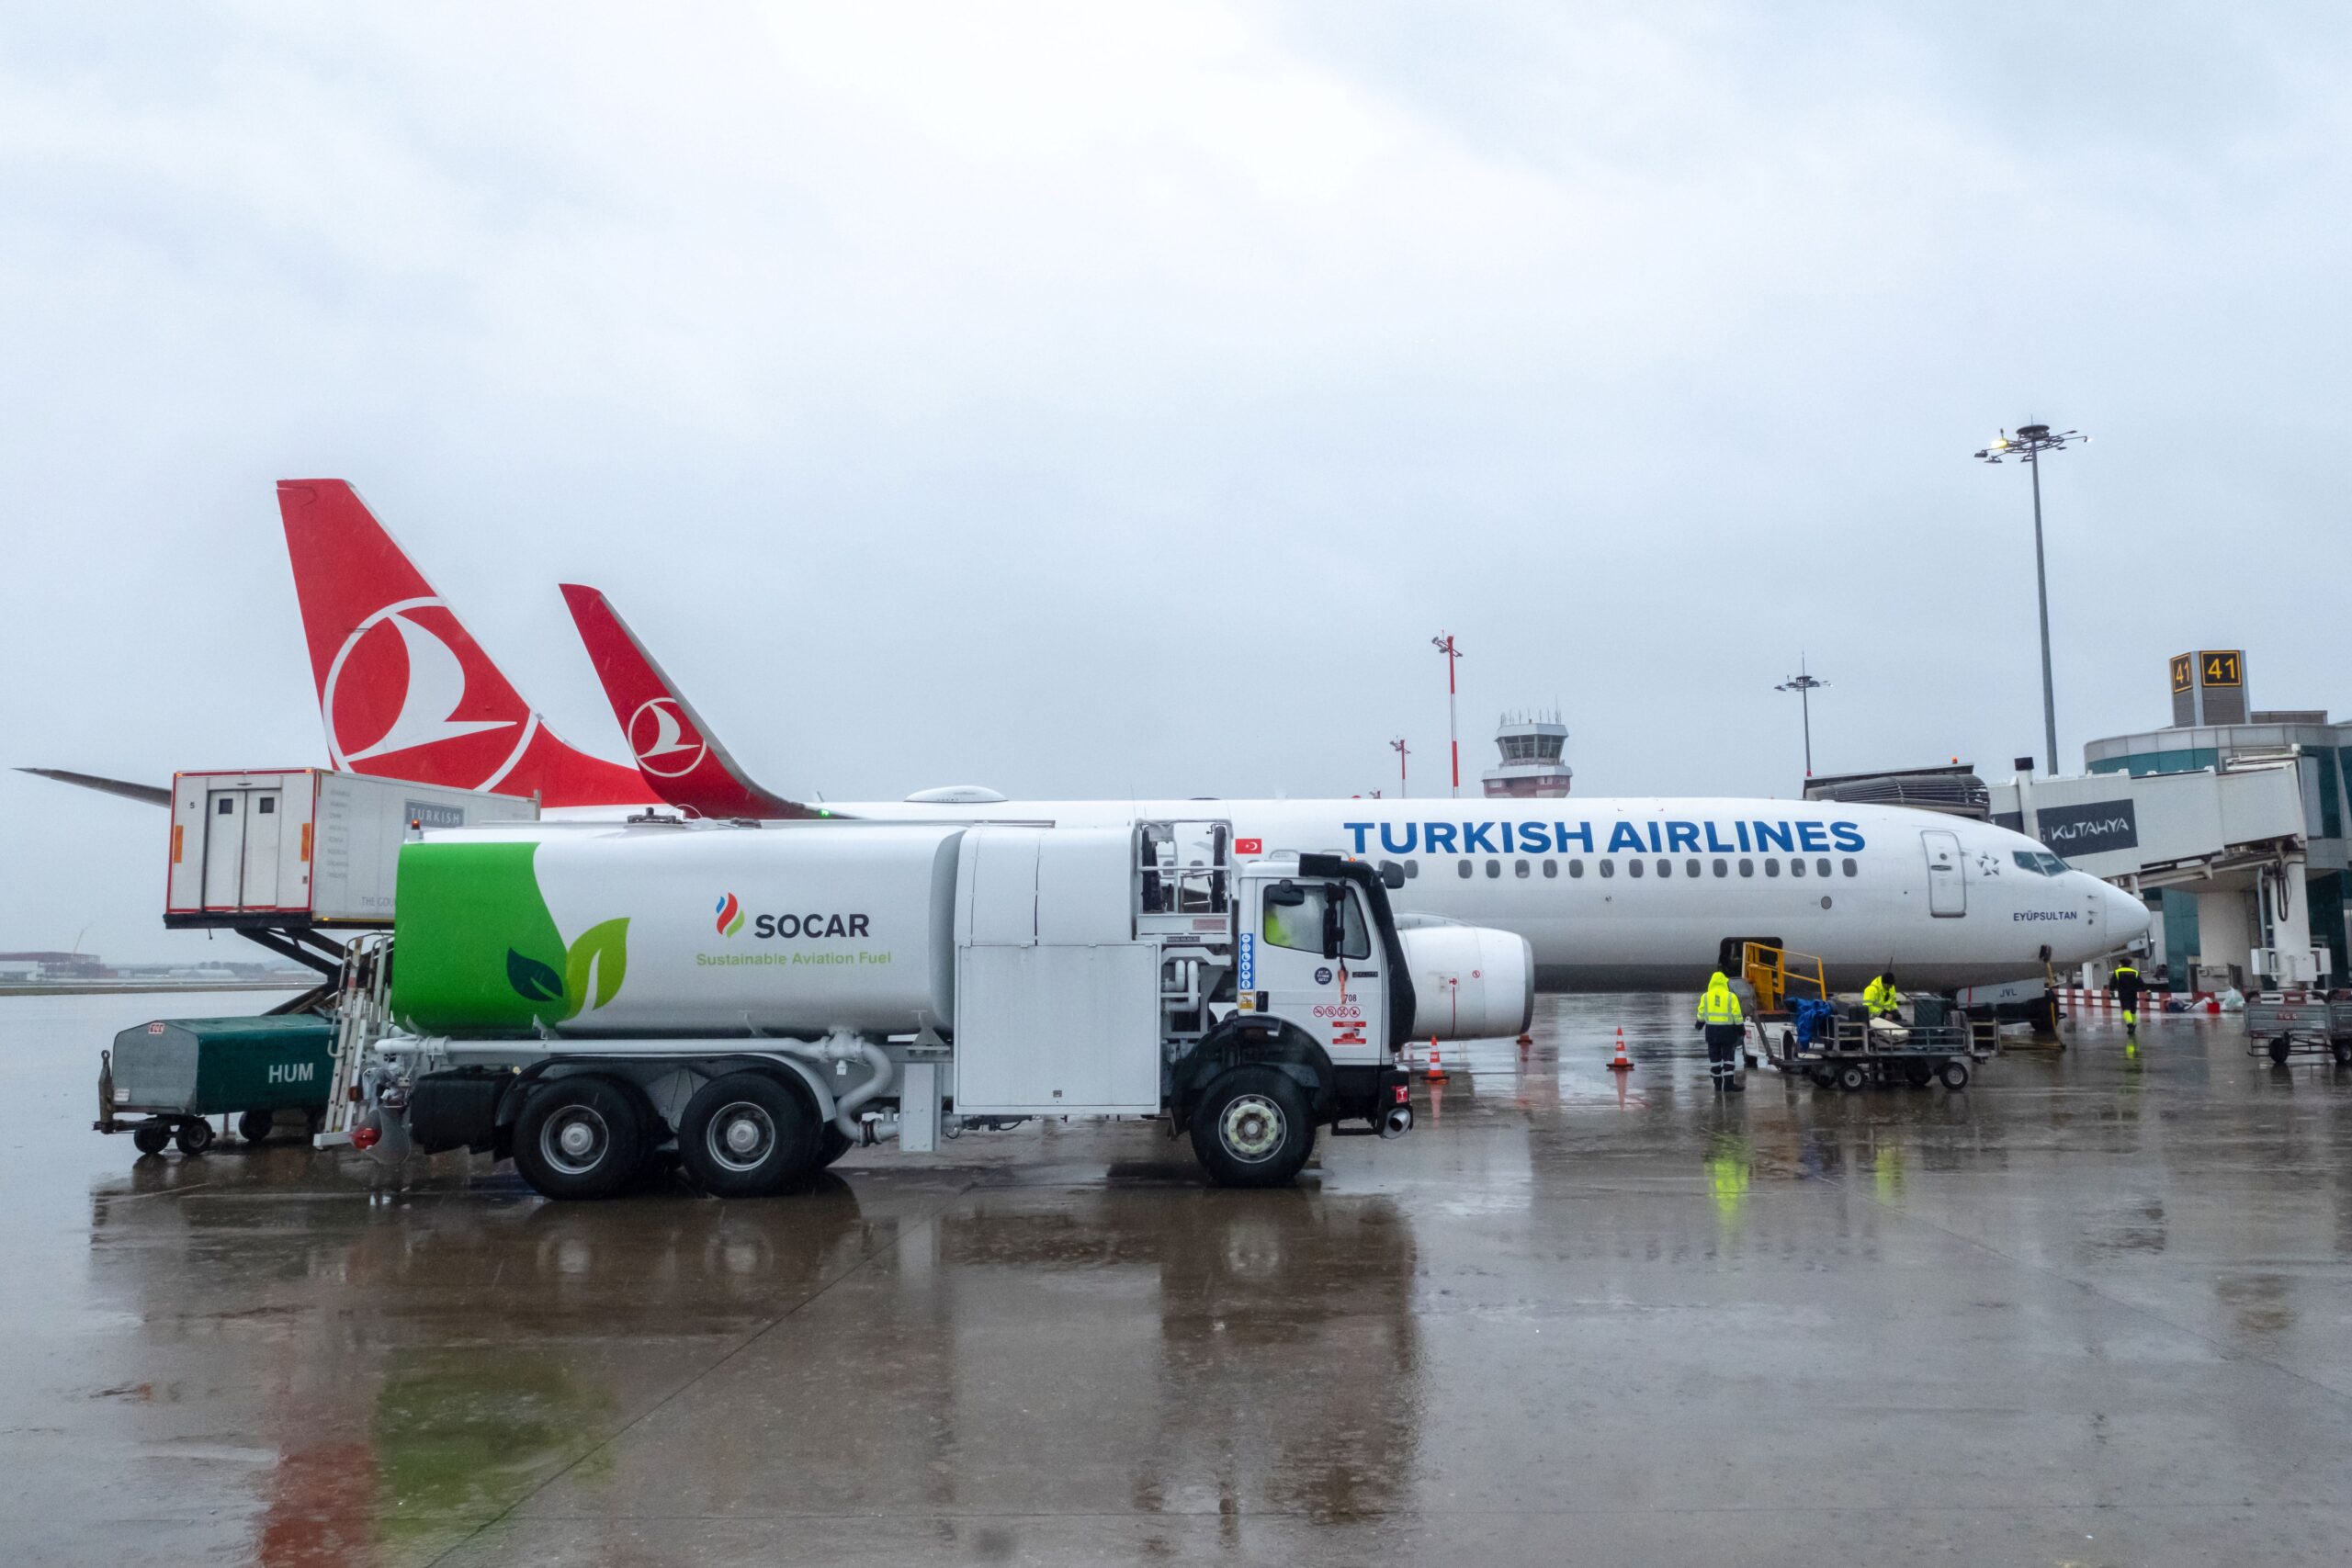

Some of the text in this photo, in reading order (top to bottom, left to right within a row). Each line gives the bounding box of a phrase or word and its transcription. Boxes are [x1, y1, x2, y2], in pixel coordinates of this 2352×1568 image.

[2176, 661, 2189, 683] 41
[2207, 658, 2235, 679] 41
[410, 807, 460, 824] TURKISH
[1343, 821, 1865, 854] TURKISH AIRLINES
[2013, 910, 2077, 921] EYÜPSULTAN
[754, 914, 870, 939] SOCAR
[695, 952, 891, 966] Sustainable Aviation Fuel
[1999, 988, 2018, 998] JVL
[268, 1062, 314, 1083] HUM
